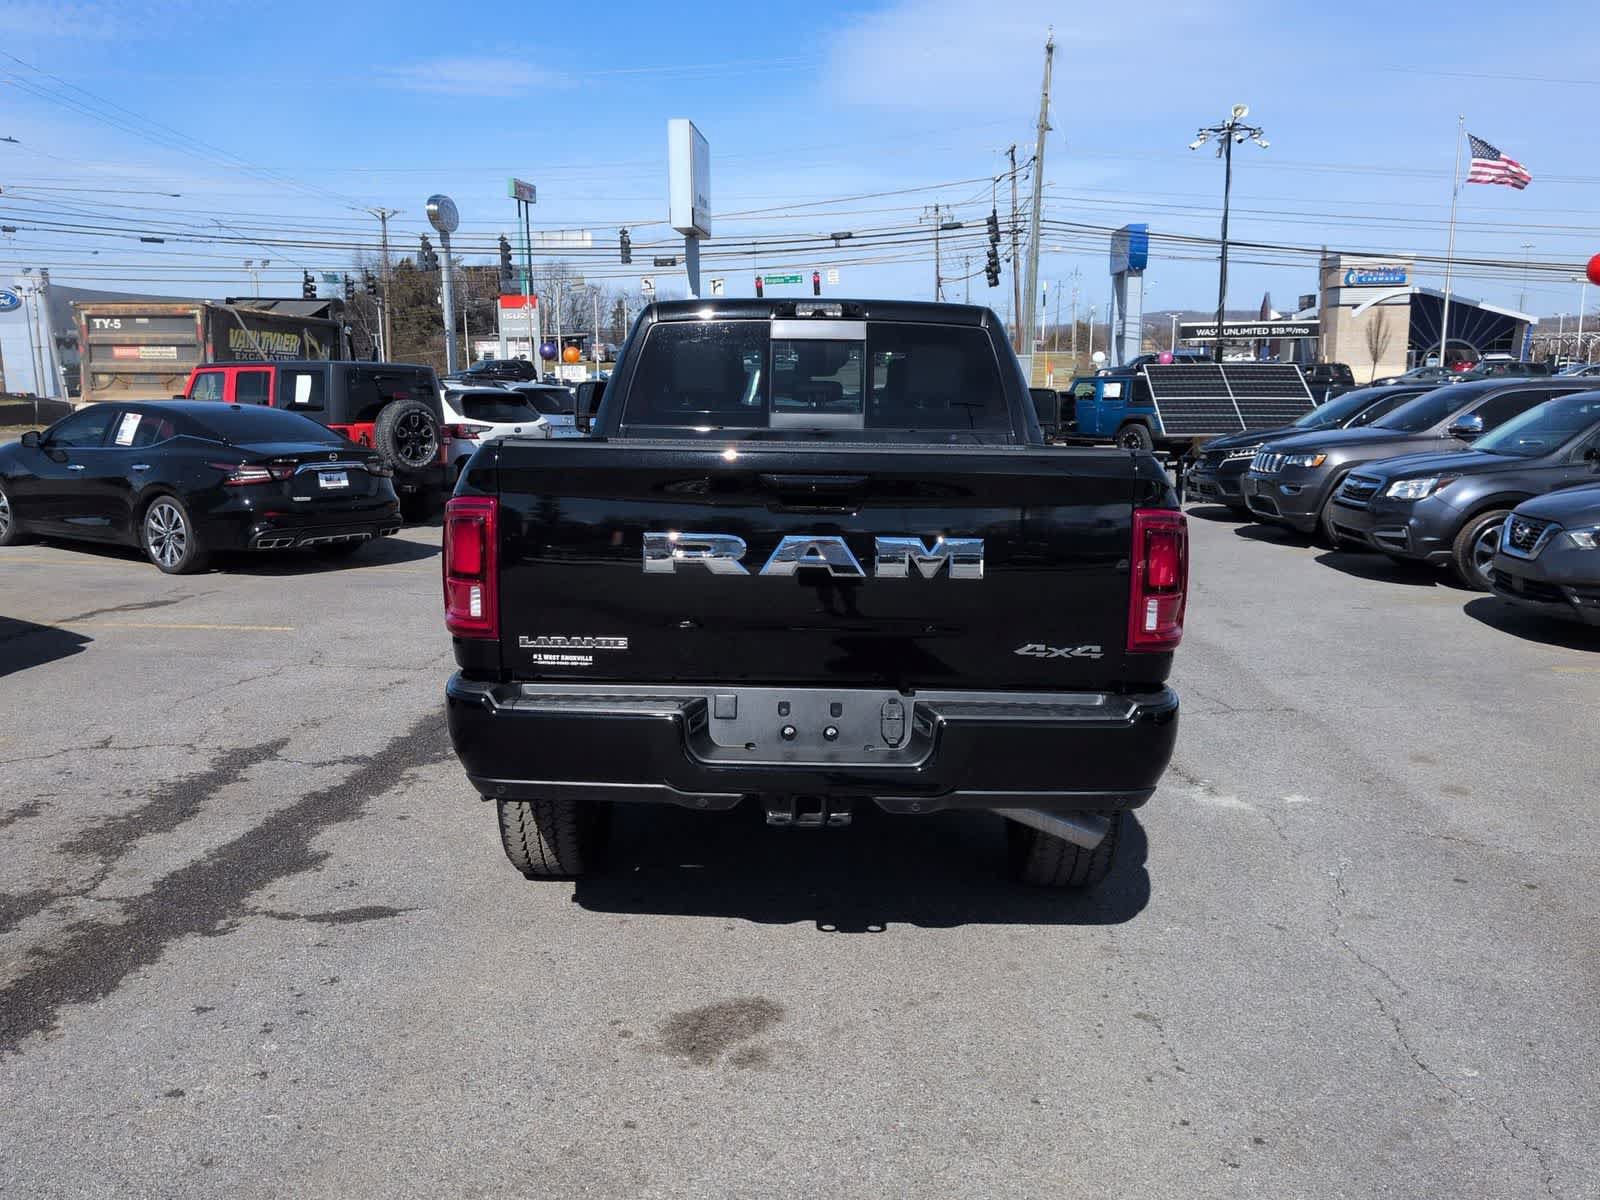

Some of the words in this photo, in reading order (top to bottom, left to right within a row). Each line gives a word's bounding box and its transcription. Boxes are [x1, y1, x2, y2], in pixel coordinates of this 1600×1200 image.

[93, 318, 122, 329] TY-5
[1196, 328, 1219, 337] WAS
[1223, 327, 1270, 336] UNLIMITED
[260, 330, 301, 355] TYLER
[642, 531, 985, 580] RAM
[518, 635, 629, 649] LARAMIE
[1013, 643, 1105, 659] 4x4
